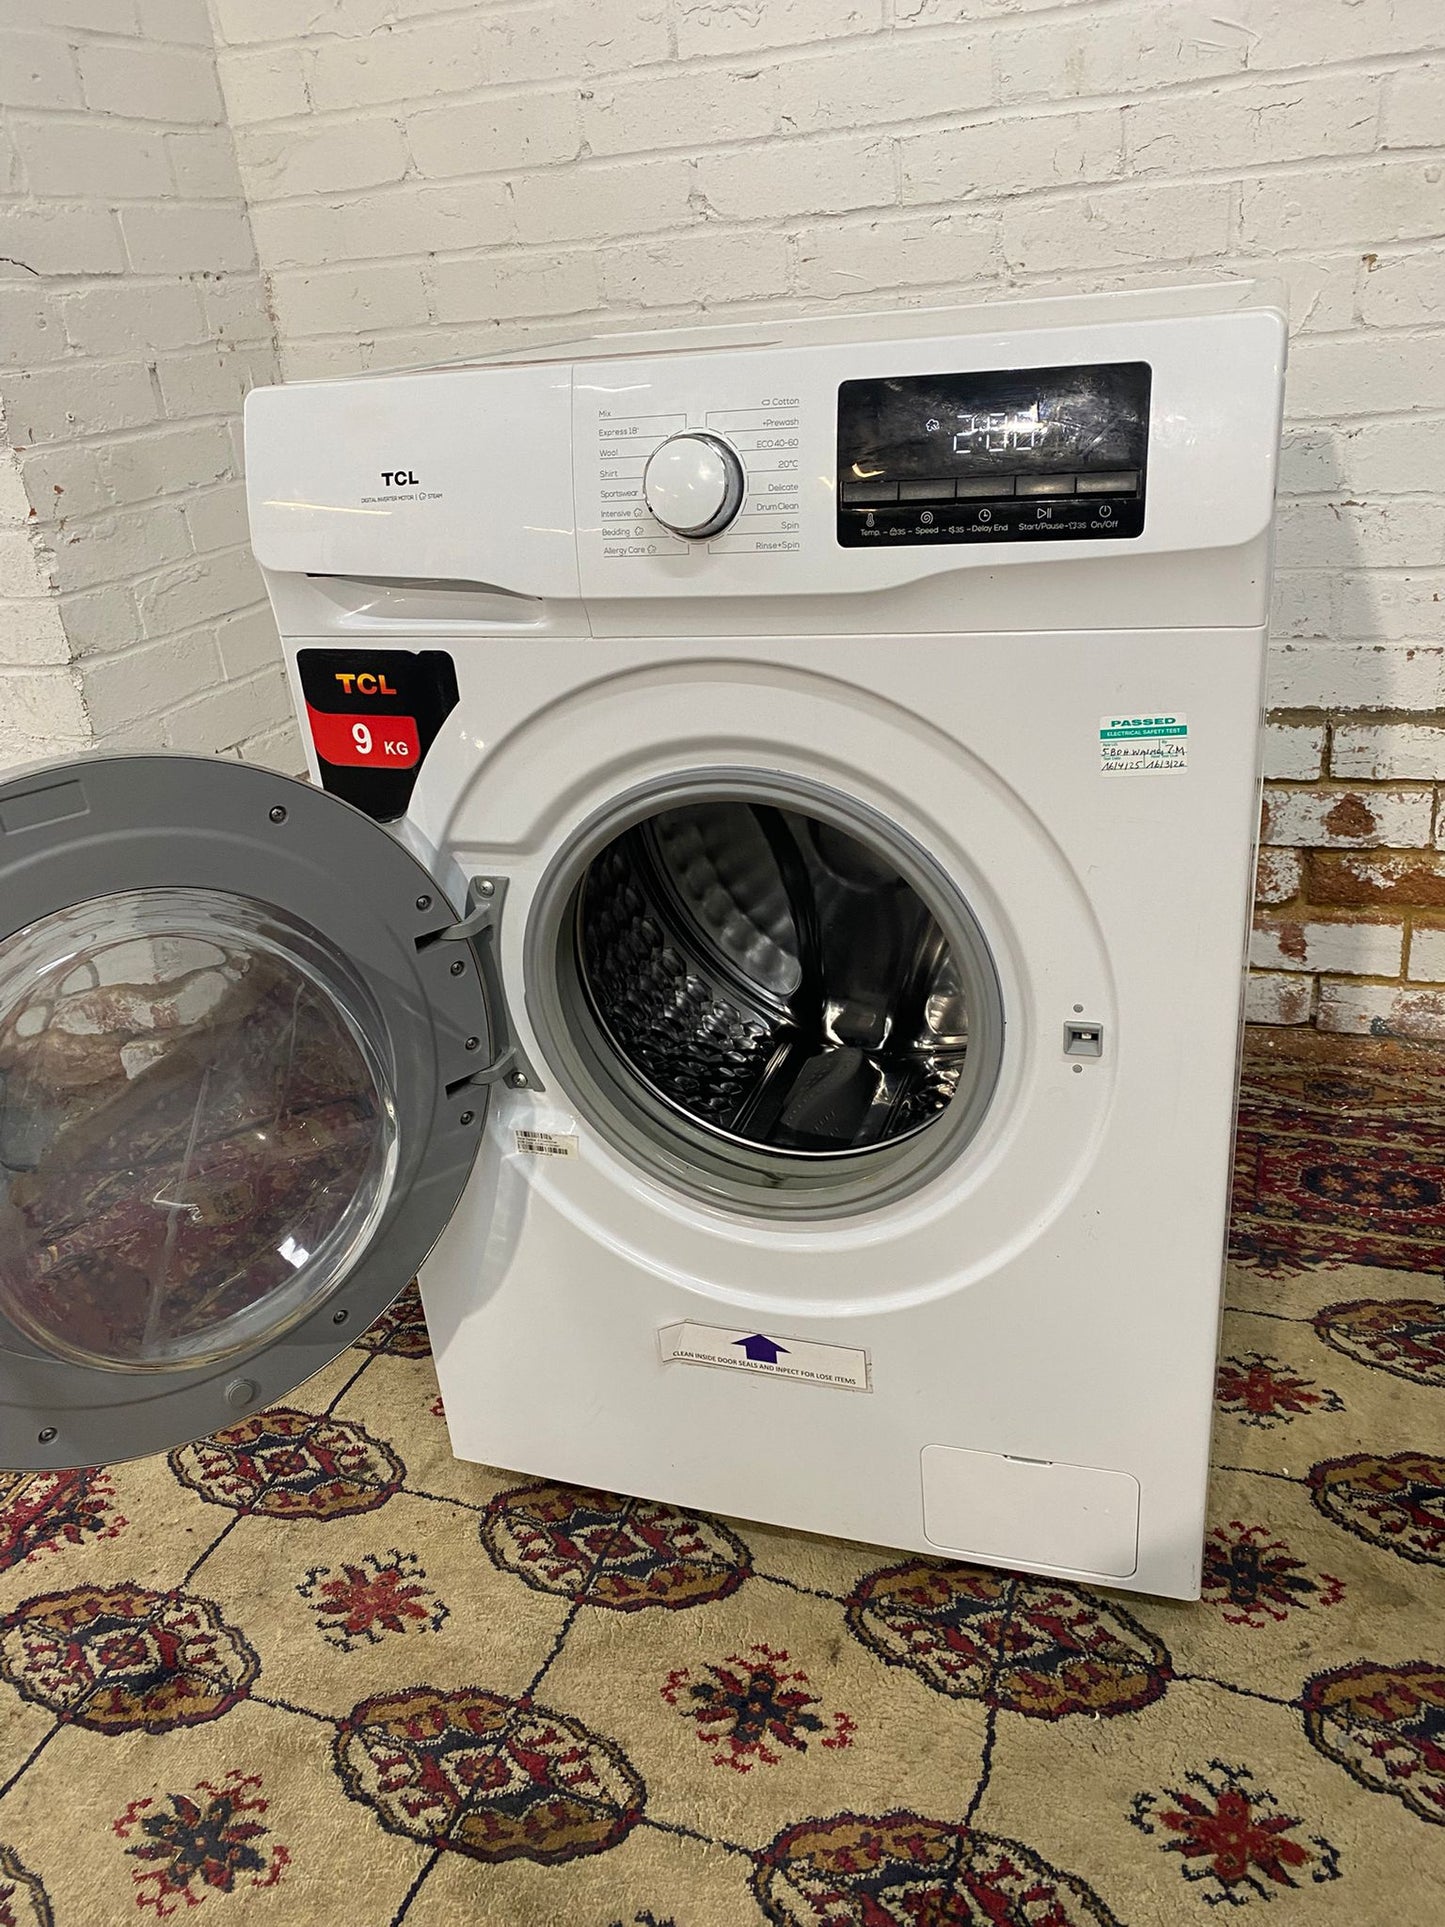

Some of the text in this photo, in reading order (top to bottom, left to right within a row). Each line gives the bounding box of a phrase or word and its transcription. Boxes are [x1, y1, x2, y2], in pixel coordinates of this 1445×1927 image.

[772, 398, 799, 406] Cotton
[599, 429, 628, 437] Express
[757, 438, 799, 448] ECO 40-60
[600, 449, 618, 457] Wool
[778, 459, 799, 468] 20°C
[381, 471, 419, 486] TCL
[600, 470, 618, 478] Shirt
[768, 483, 799, 492] Delicate
[601, 490, 638, 499] Sportswear
[601, 510, 631, 518] Intensive
[781, 521, 800, 530] Spin
[993, 524, 1009, 532] End
[1090, 520, 1119, 529] On/Off
[602, 528, 630, 538] Bedding
[860, 528, 880, 536] Temp.
[915, 526, 939, 535] Speed
[756, 541, 800, 550] Rinse+Spin
[603, 546, 646, 556] Allergy Care
[335, 673, 397, 695] TCL
[1111, 717, 1176, 727] PASSED
[1107, 729, 1141, 737] ELECTRICAL
[352, 723, 409, 756] 9 KG
[672, 1350, 856, 1385] CLEAN INSIDE DOOR SEALS AND INPECT FOR LOSE ITEMS
